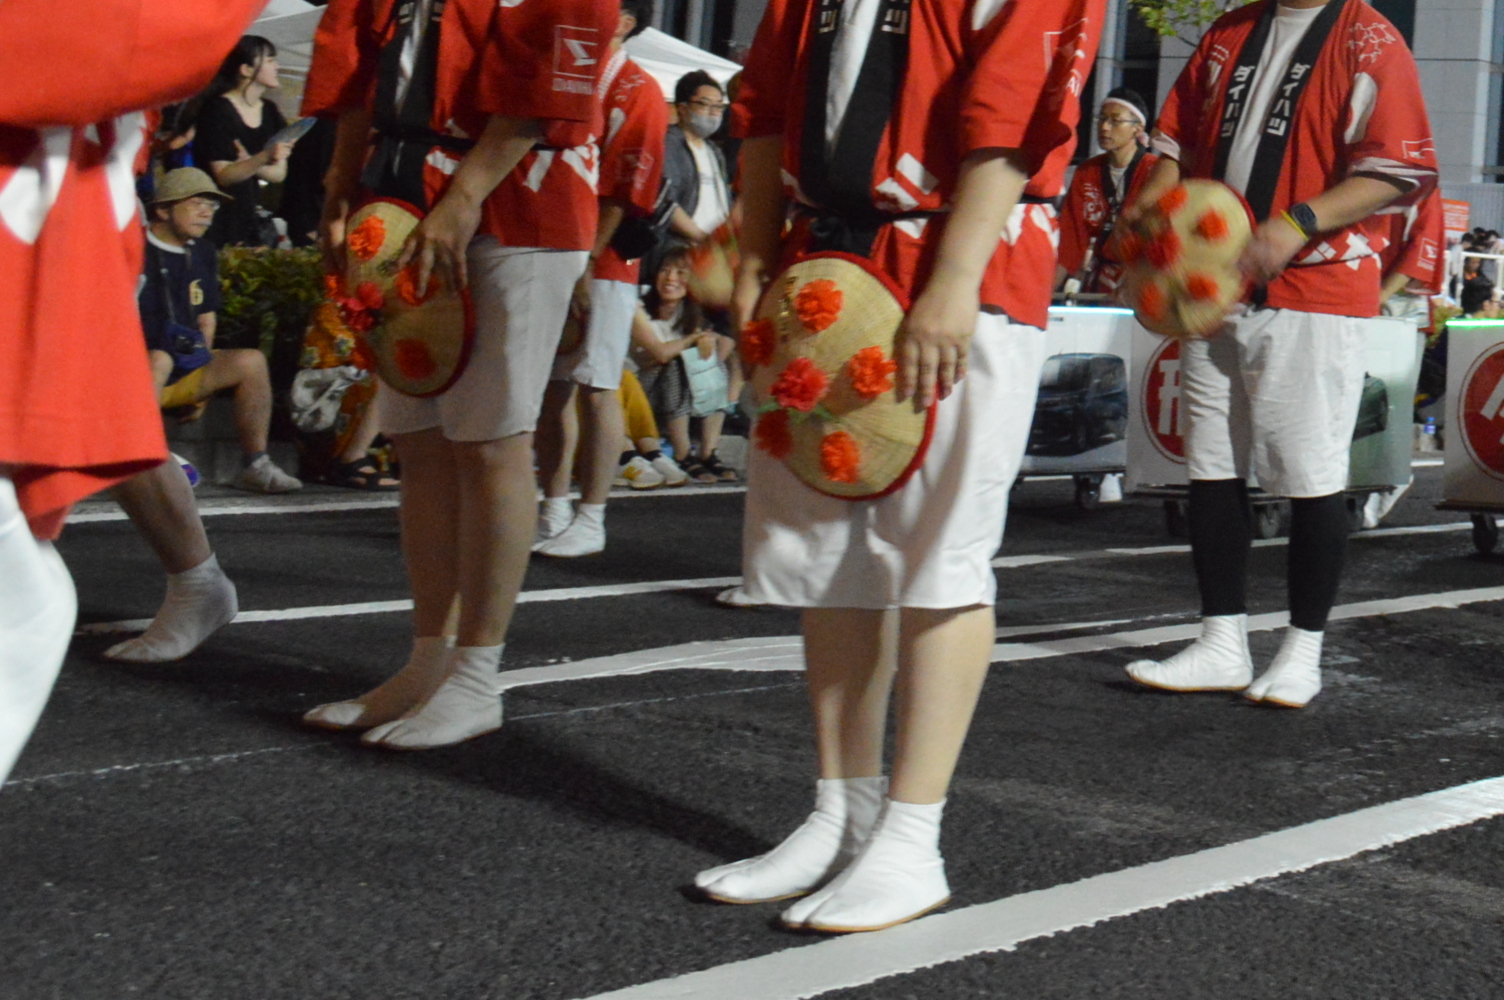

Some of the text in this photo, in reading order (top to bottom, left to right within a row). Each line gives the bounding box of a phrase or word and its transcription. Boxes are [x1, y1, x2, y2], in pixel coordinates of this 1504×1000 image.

[1219, 64, 1256, 138] ダイハツ
[1265, 62, 1312, 137] ダイハツ
